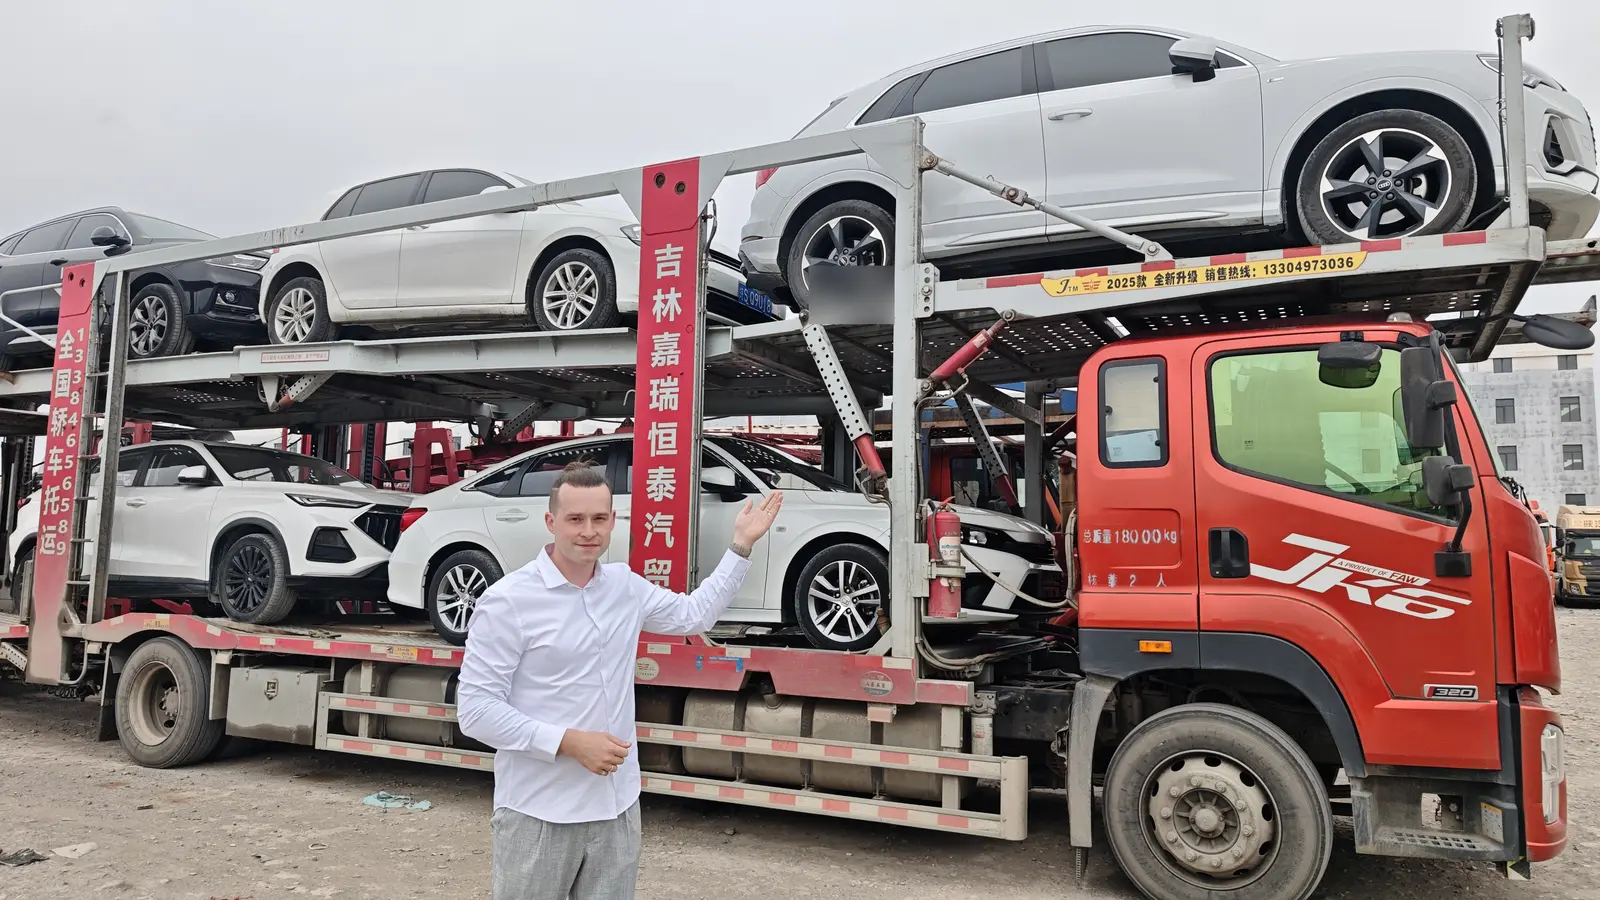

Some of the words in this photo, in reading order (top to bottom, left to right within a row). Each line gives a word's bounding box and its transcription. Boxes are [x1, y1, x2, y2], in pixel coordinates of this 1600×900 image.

[1107, 274, 1147, 290] 2025款
[1154, 270, 1198, 287] 全新升级
[1263, 256, 1355, 275] 13304973036
[40, 329, 75, 556] 全国轿车托运
[56, 327, 85, 556] 13384656589
[1344, 562, 1377, 574] PRODUCT
[1389, 572, 1419, 584] FAW
[1434, 688, 1474, 697] 320
